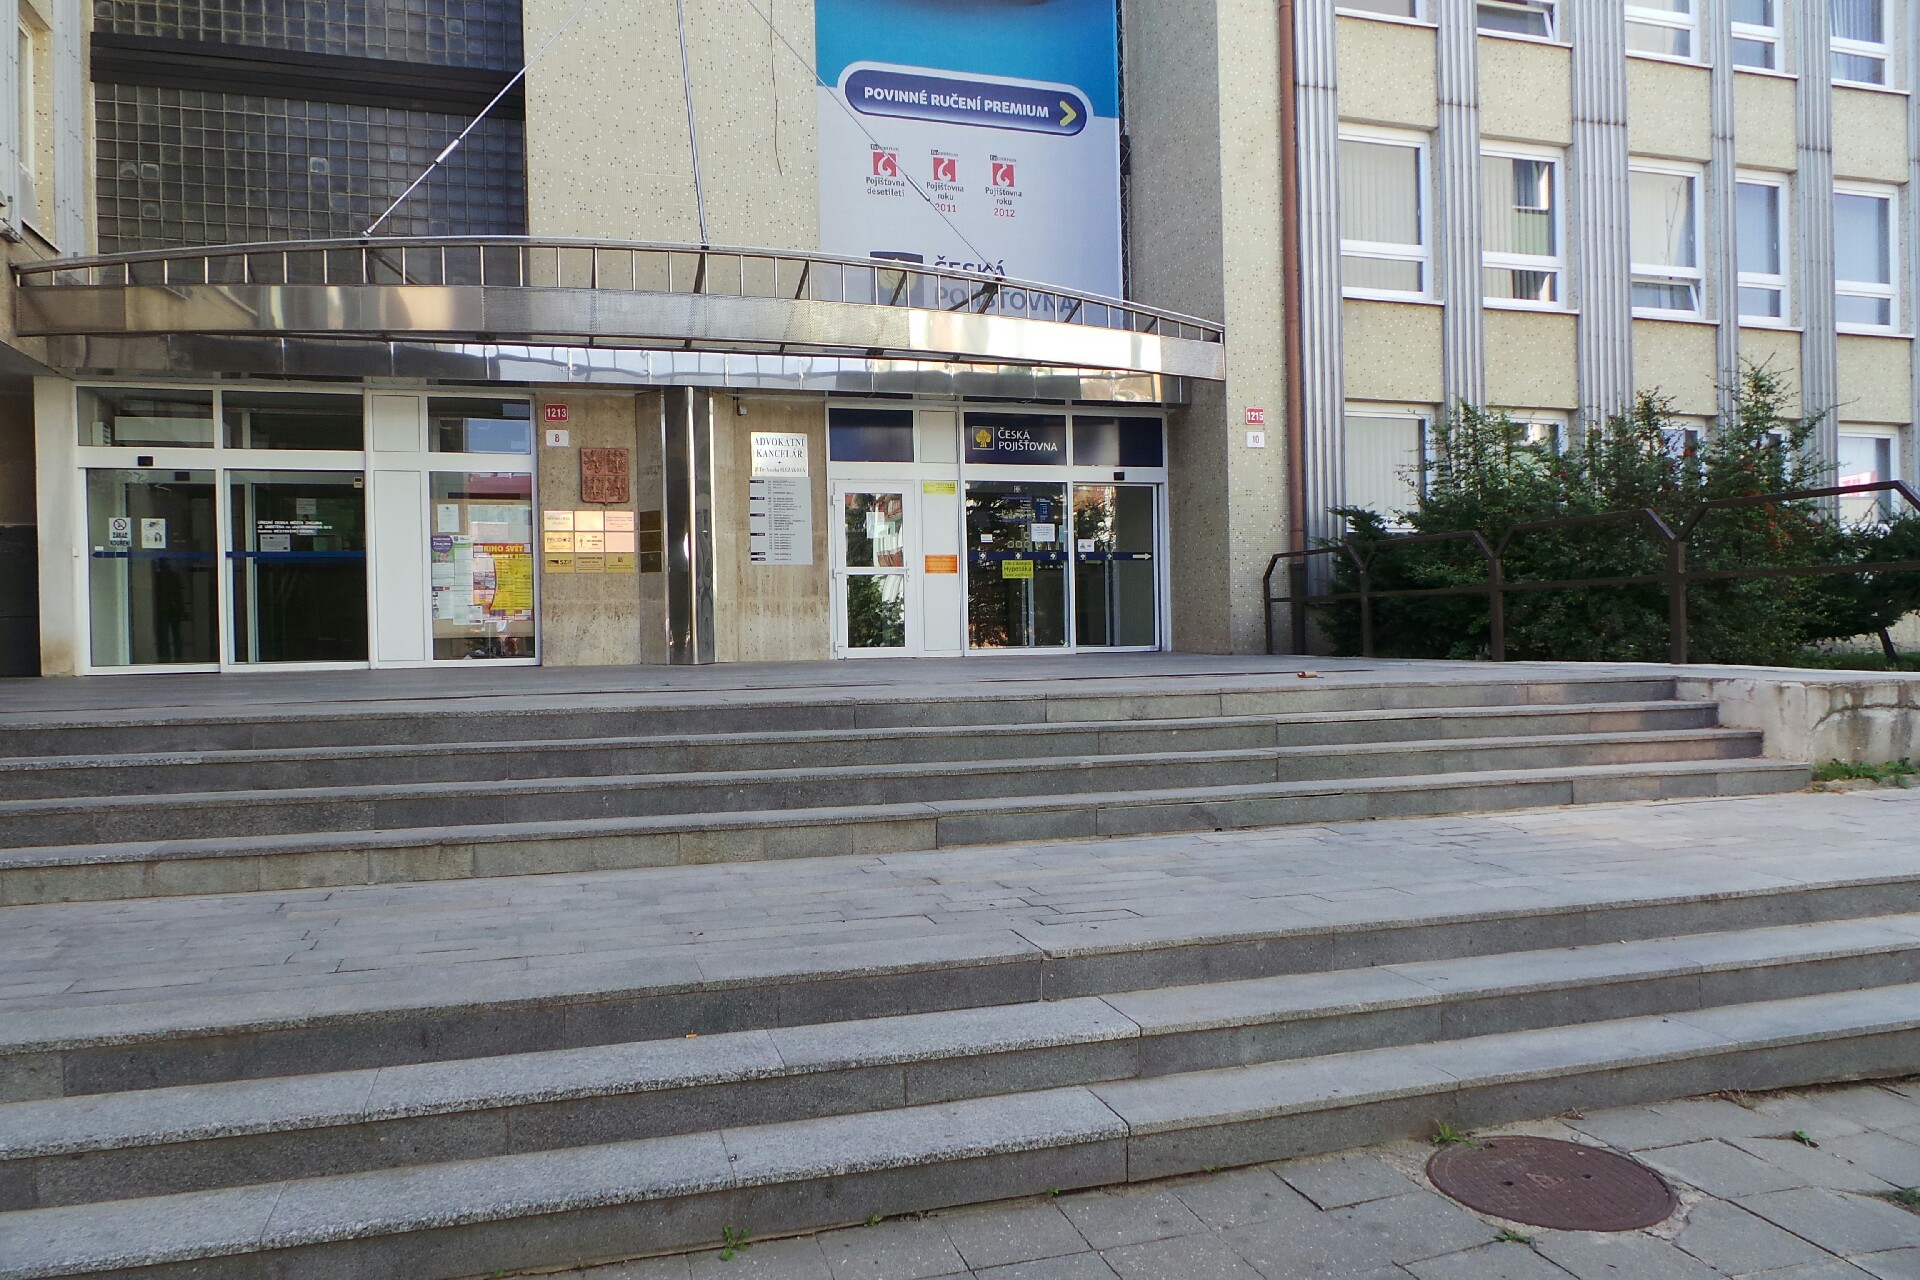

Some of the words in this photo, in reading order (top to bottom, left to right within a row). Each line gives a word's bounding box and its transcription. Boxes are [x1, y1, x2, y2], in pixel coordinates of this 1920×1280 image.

[864, 86, 928, 105] POVINNÉ
[930, 93, 981, 111] RUČENÍ
[984, 99, 1050, 118] PREMIUM
[937, 193, 955, 201] roku
[996, 198, 1013, 206] roku
[934, 203, 957, 213] 2011
[993, 207, 1016, 218] 2012
[546, 407, 567, 418] 1213
[1247, 411, 1264, 421] 1215
[554, 433, 560, 443] 8
[997, 426, 1031, 440] ČESKÁ
[1252, 435, 1260, 444] 10
[998, 439, 1058, 452] POJIŠŤOVNA
[483, 545, 504, 553] KINO
[506, 543, 524, 553] SVĚT
